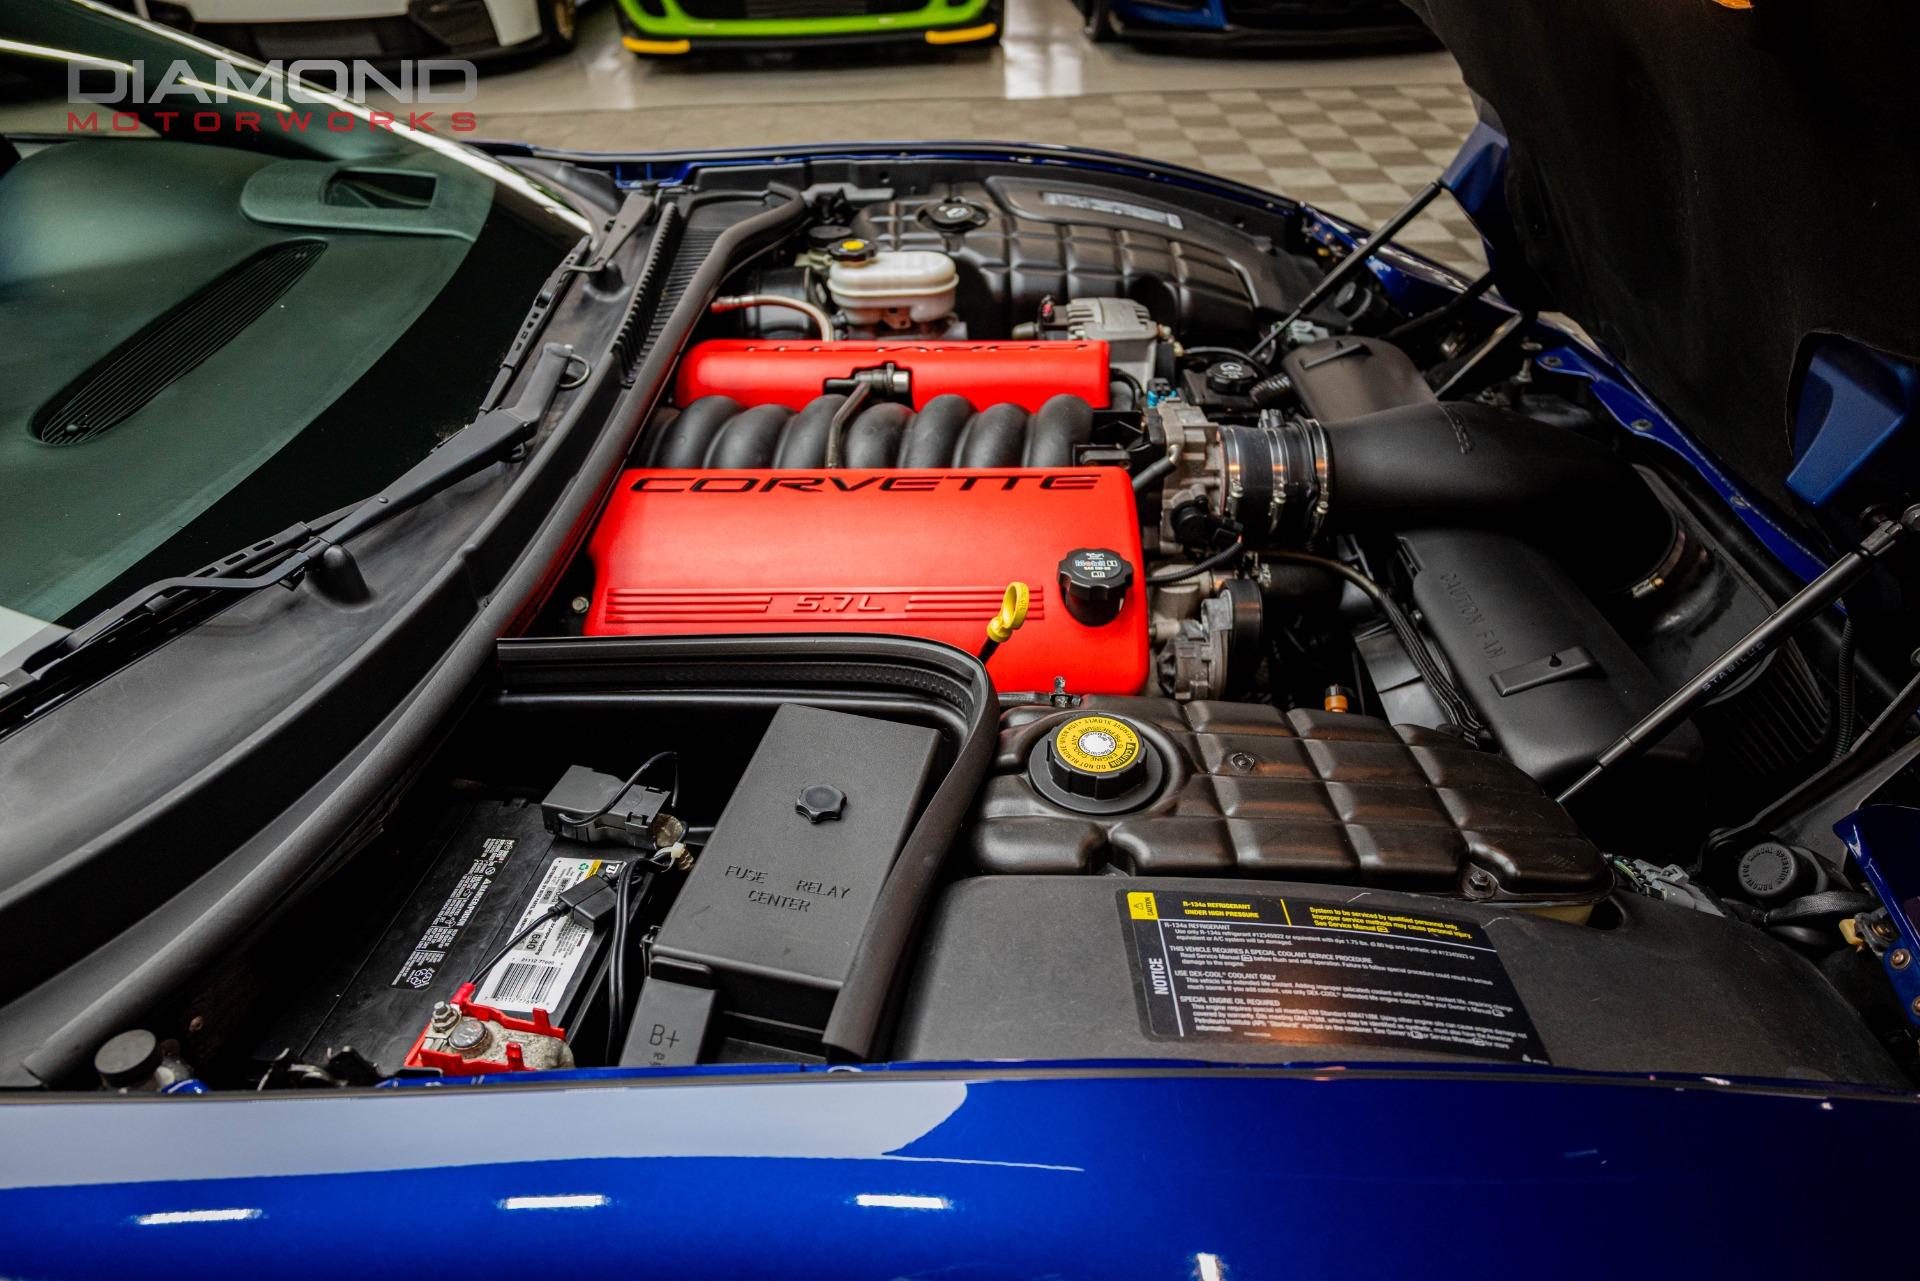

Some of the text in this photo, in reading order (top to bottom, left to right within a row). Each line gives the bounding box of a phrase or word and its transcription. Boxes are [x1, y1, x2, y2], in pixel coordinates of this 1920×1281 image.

[630, 474, 1101, 492] CORVETTE
[793, 594, 885, 612] 5.7L
[1440, 574, 1506, 659] CAUTION FAN
[1702, 640, 1766, 692] STABILUS
[1091, 752, 1118, 762] ENGINE
[1110, 750, 1133, 767] CAUTION
[725, 866, 850, 898] FUSE RELAY
[748, 890, 810, 912] CENTER
[1145, 897, 1154, 916] CAUTION
[1310, 906, 1332, 914] System
[1350, 911, 1377, 919] serviced
[1312, 913, 1340, 922] Improper
[527, 934, 540, 950] 640
[1148, 958, 1169, 996] NOTICE
[650, 1024, 680, 1048] B+
